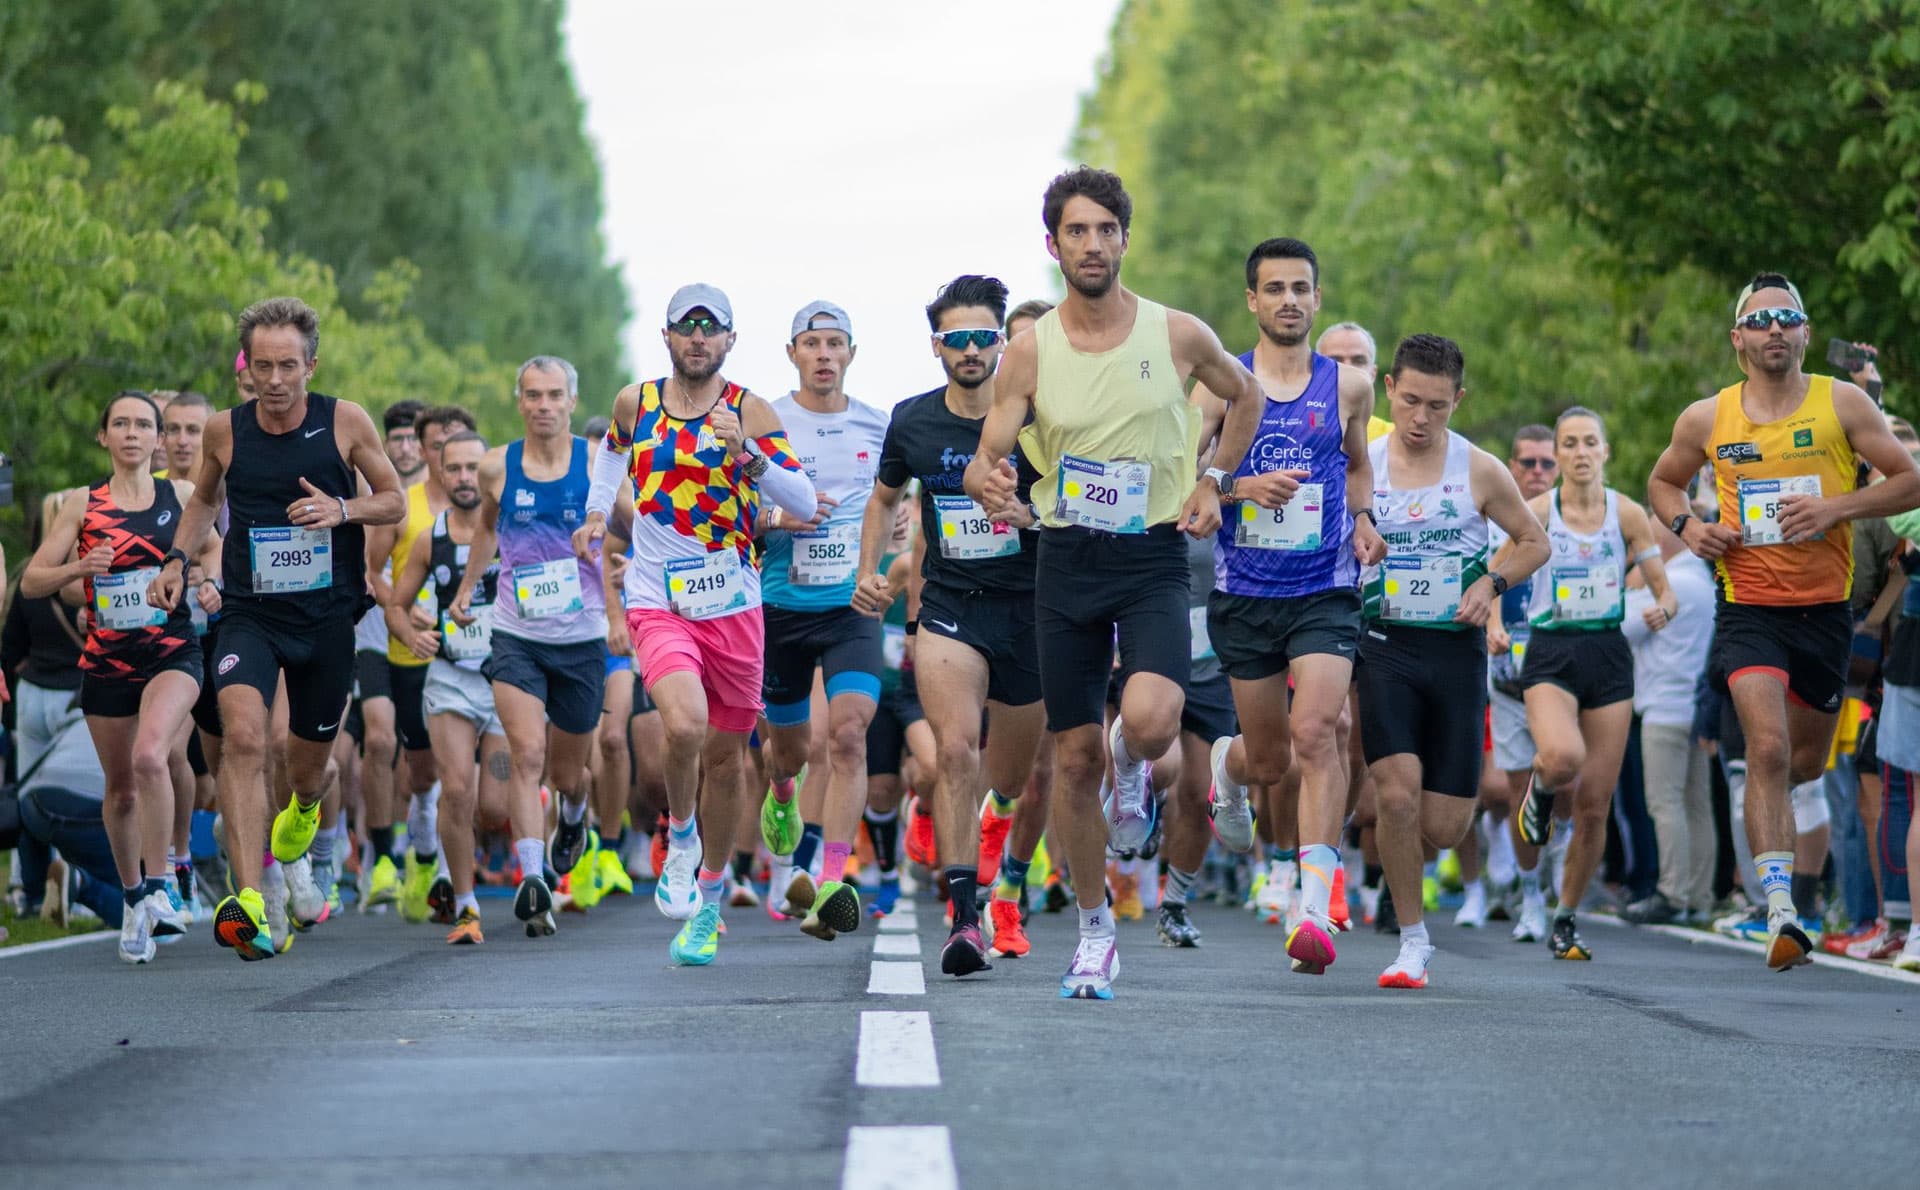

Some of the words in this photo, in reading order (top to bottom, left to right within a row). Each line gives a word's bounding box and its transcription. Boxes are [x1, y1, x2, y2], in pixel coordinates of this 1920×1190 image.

[1261, 443, 1313, 459] Cercle
[1261, 460, 1286, 471] Paul
[1288, 460, 1312, 471] Bert
[1085, 483, 1118, 505] 220
[1274, 508, 1284, 524] 8
[960, 519, 990, 536] 136
[1381, 531, 1413, 545] NEUIL
[1419, 528, 1462, 544] SPORTS
[271, 550, 312, 568] 2993
[809, 543, 846, 559] 5582
[533, 581, 560, 597] 203
[686, 573, 725, 595] 2419
[1409, 580, 1430, 596] 22
[1579, 585, 1594, 599] 21
[113, 592, 141, 608] 219
[463, 625, 482, 639] 191
